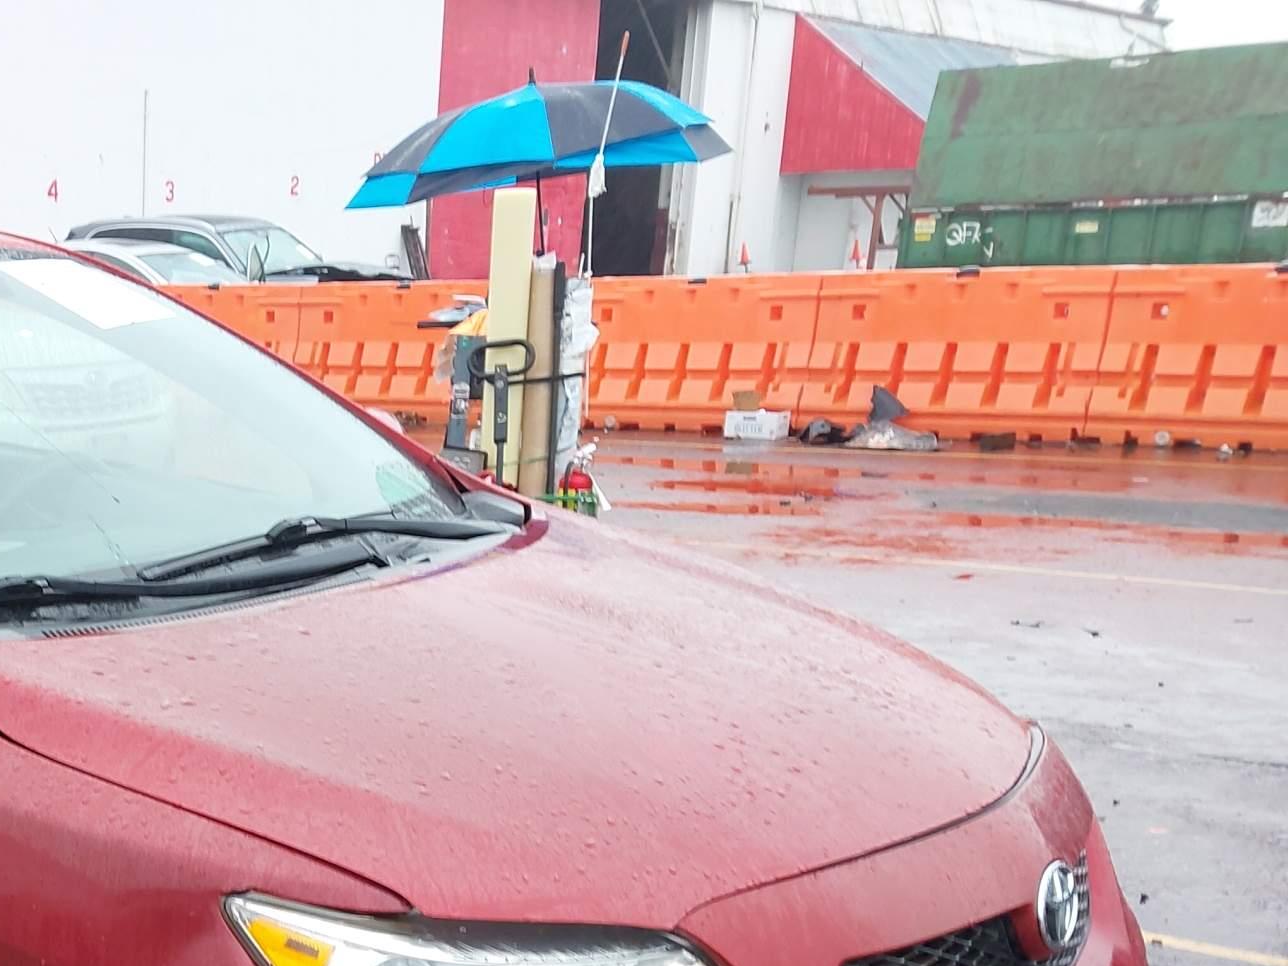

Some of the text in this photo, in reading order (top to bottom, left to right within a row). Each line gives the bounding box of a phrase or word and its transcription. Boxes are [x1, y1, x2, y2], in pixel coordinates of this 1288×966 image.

[47, 178, 59, 203] 4
[165, 180, 175, 203] 3
[290, 175, 300, 197] 2
